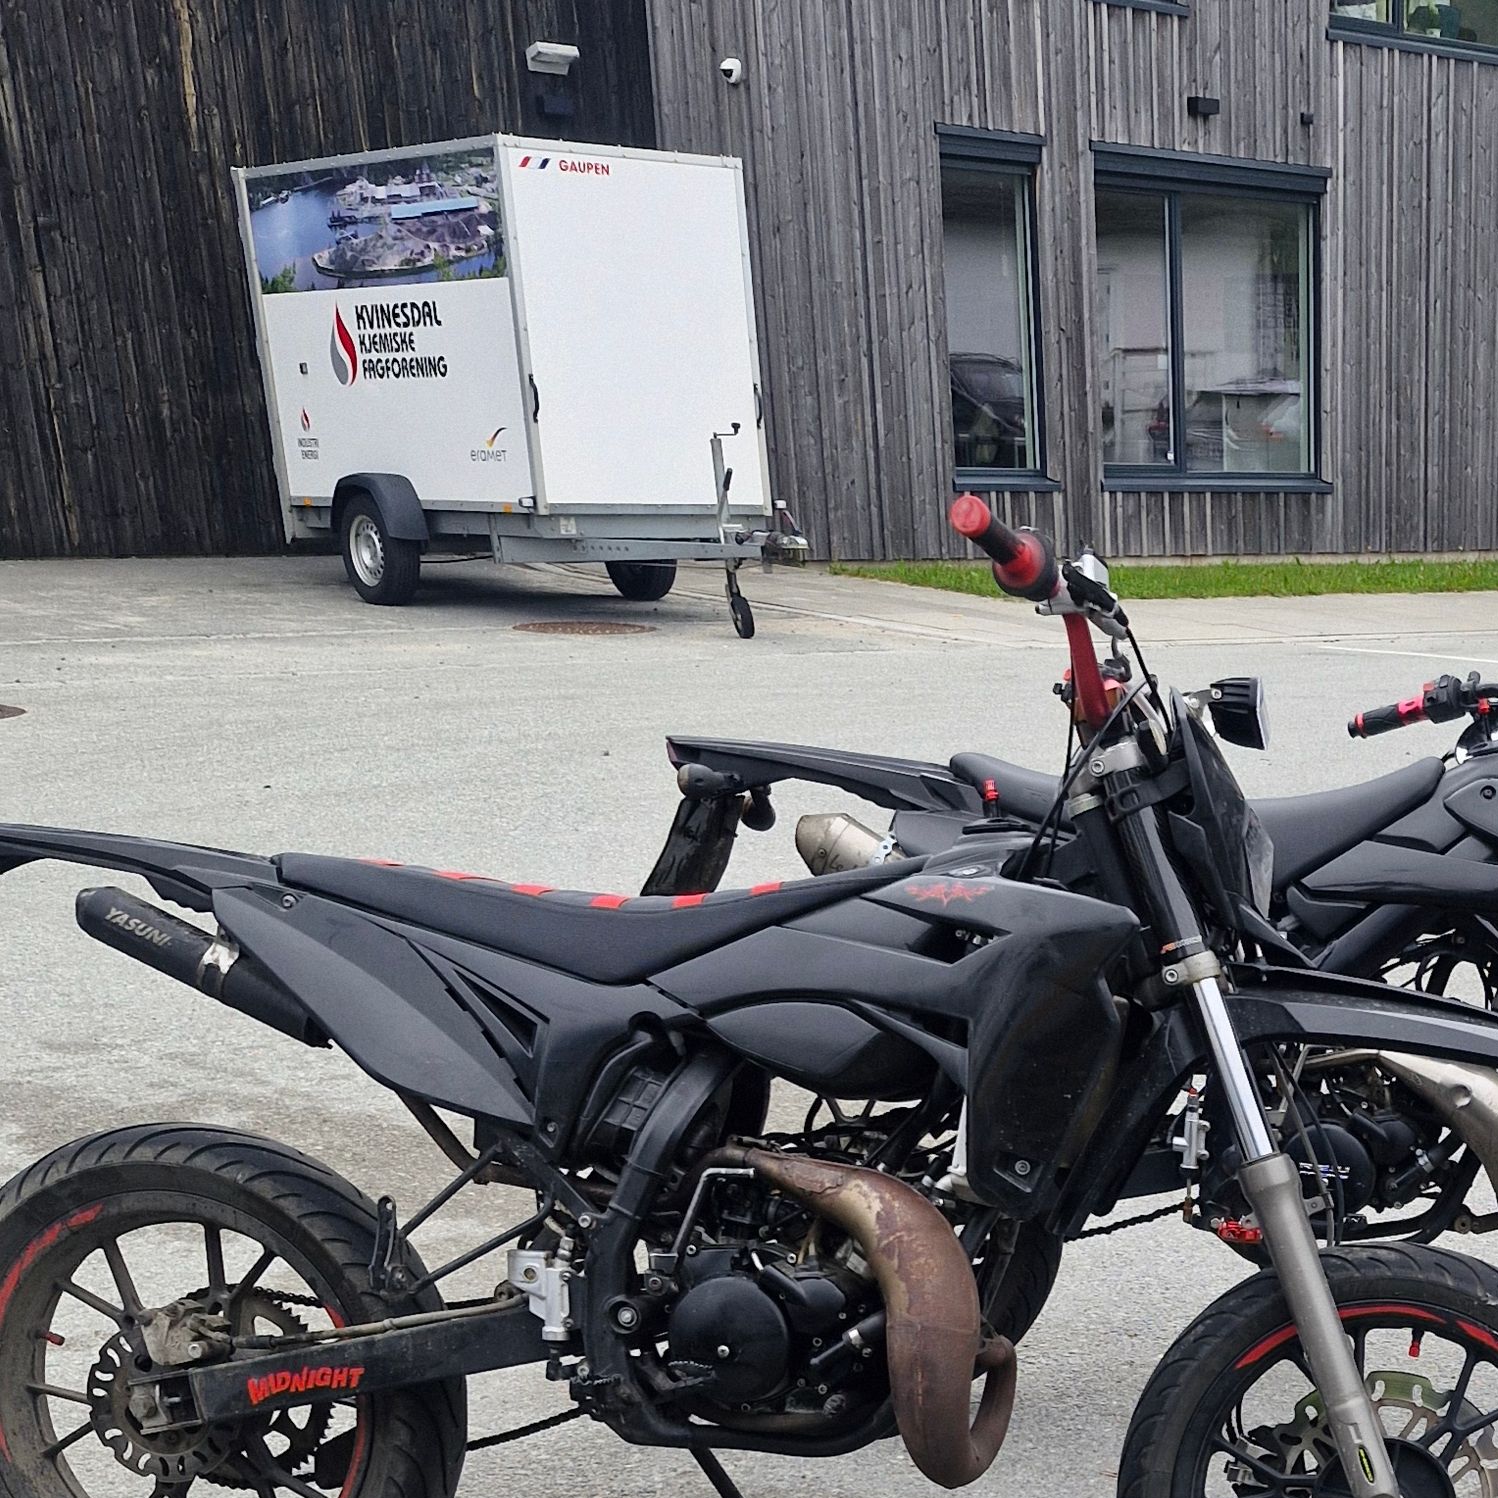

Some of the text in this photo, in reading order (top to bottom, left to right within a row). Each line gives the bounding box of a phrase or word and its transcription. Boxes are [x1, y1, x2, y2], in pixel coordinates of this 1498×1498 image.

[559, 160, 610, 175] GAUPEN
[355, 301, 442, 330] KVINESDAL
[358, 331, 416, 354] KJEMISKE
[362, 355, 448, 380] FAGFORENING
[104, 906, 172, 947] YASUNI
[246, 1366, 365, 1406] MIDNIGHT
